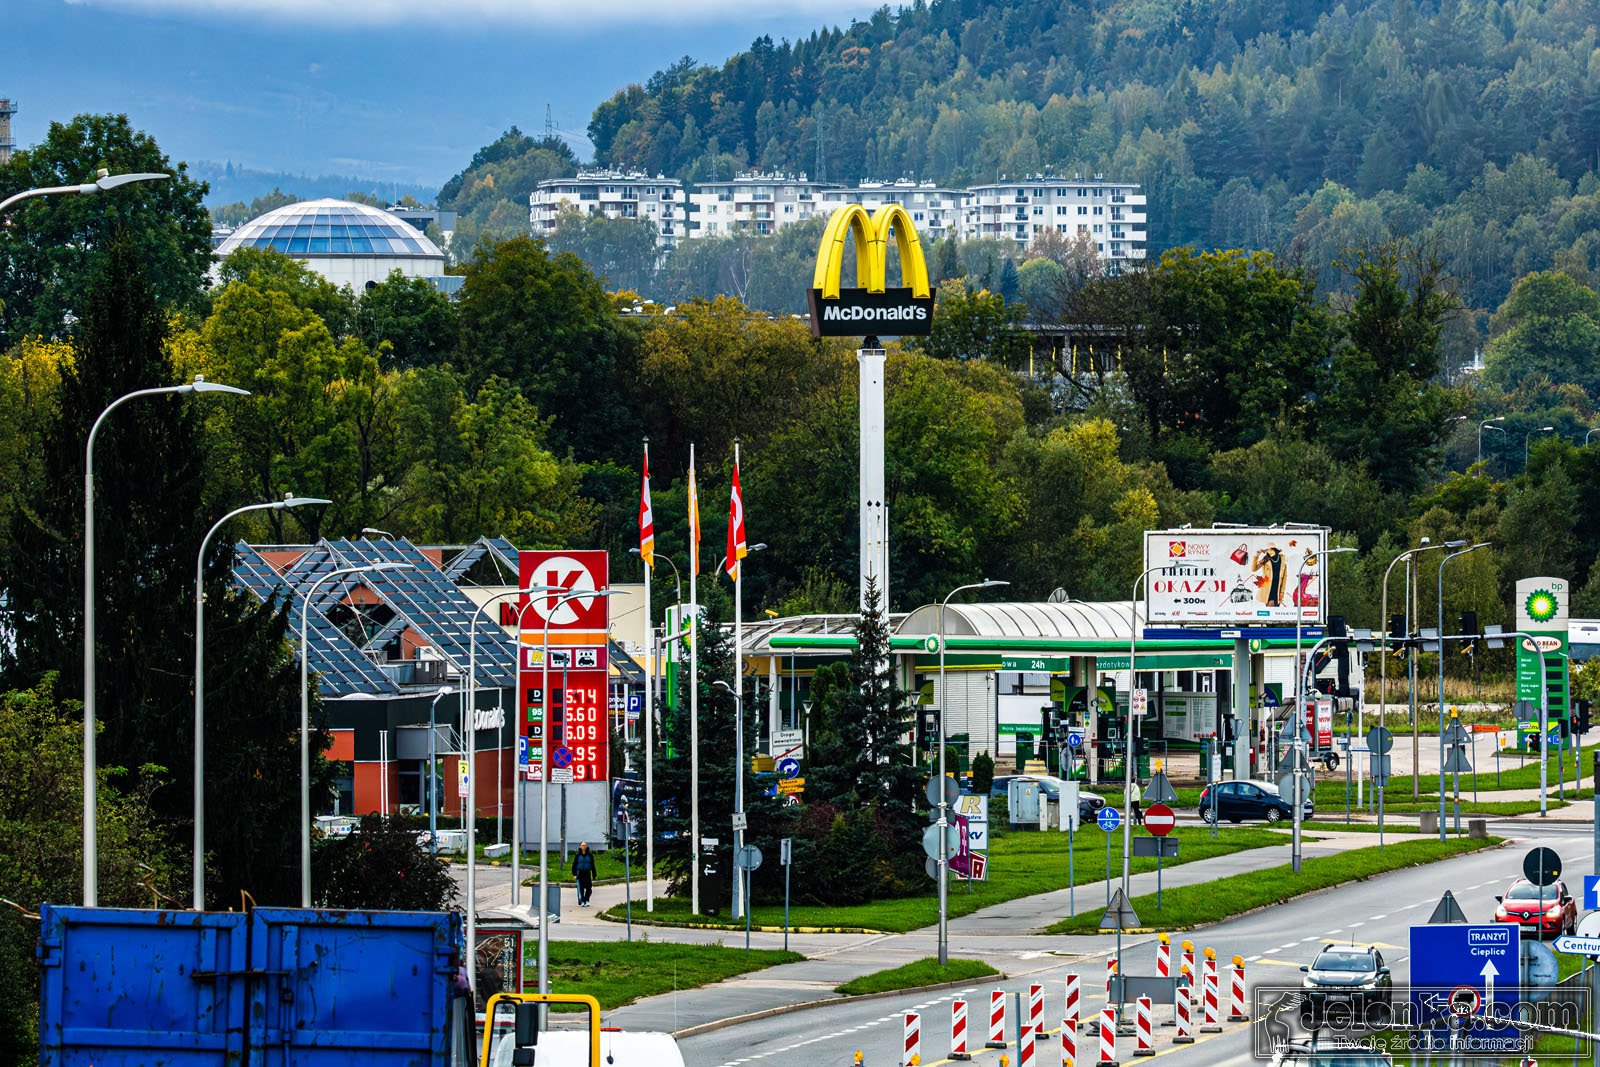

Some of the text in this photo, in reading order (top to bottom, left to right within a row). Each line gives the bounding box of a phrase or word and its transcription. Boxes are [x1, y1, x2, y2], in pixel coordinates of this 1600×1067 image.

[824, 305, 927, 320] McDonald's
[1153, 580, 1226, 593] OKAZJI
[1551, 582, 1563, 591] bp
[1031, 660, 1045, 669] 24h
[533, 690, 541, 698] D
[630, 697, 639, 710] P
[532, 707, 543, 716] 95
[532, 746, 597, 761] 95 .95
[568, 765, 597, 779] .91
[1471, 932, 1507, 941] TRANZYT
[1471, 947, 1506, 957] Cieplice
